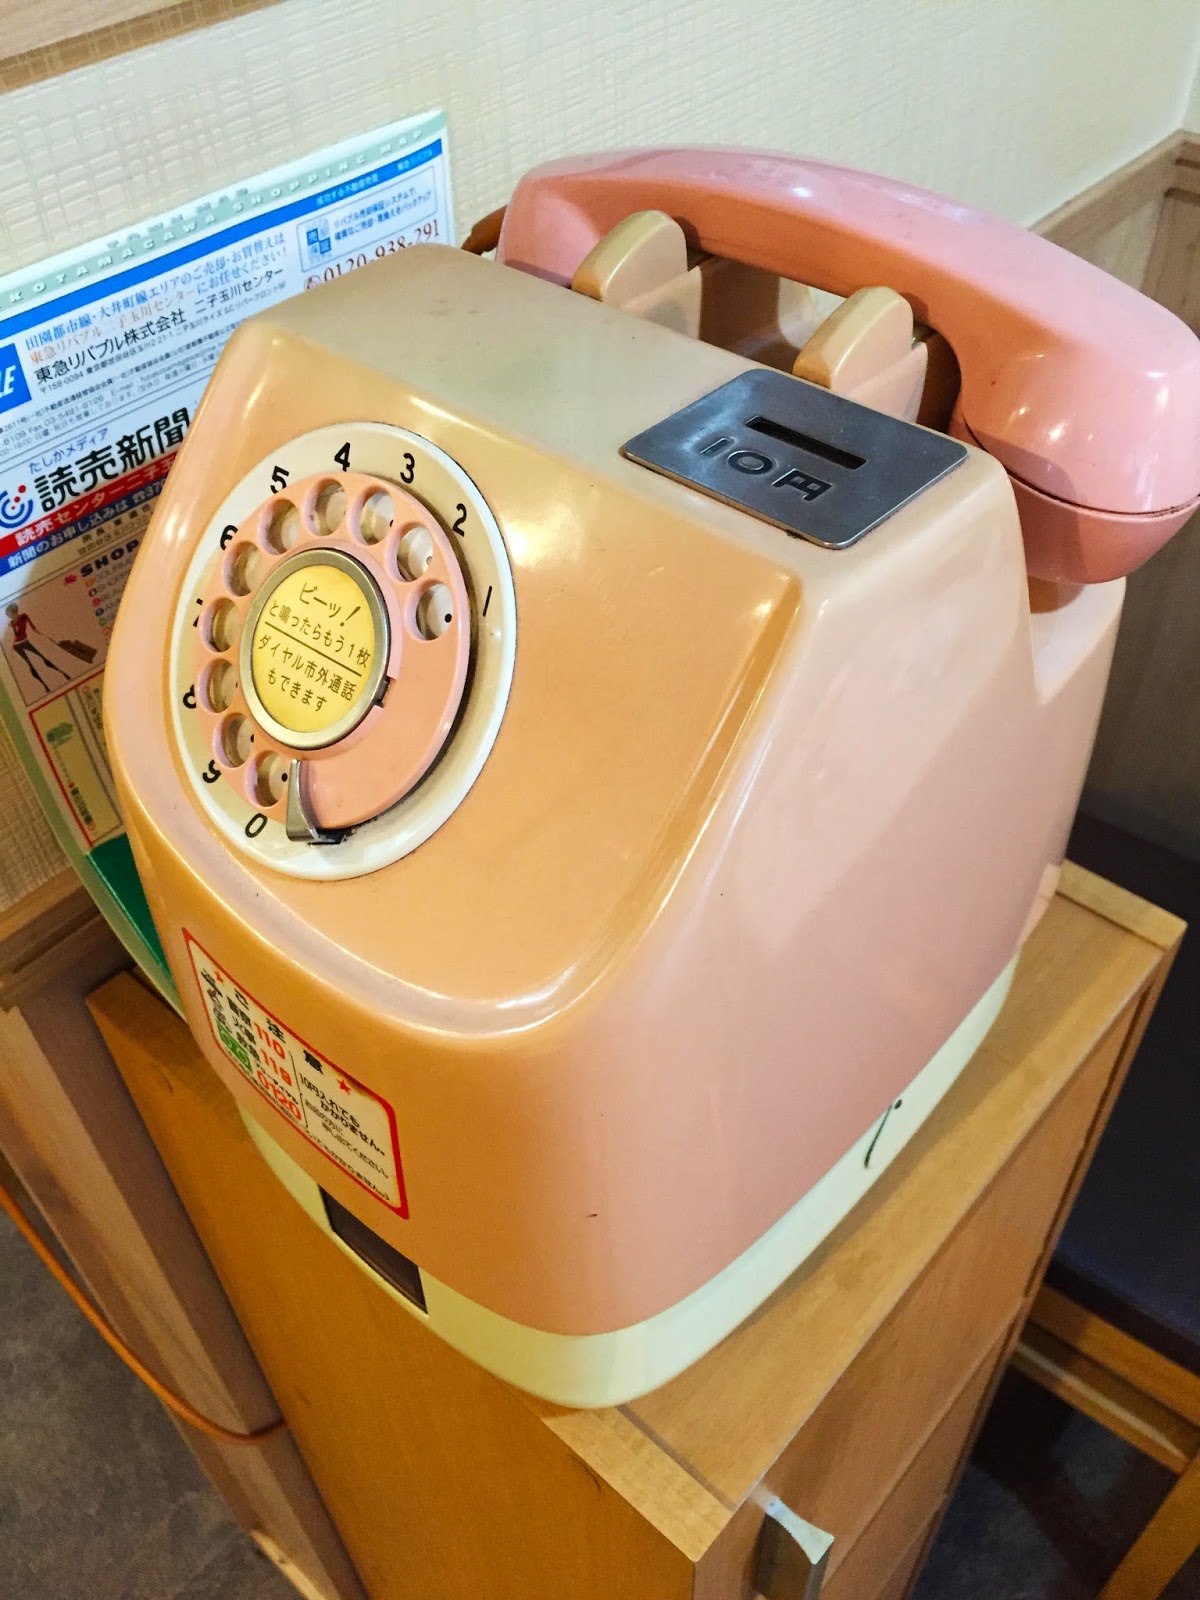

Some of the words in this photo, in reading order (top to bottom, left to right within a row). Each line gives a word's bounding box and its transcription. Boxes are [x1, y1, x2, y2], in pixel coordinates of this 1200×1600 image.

[0, 213, 216, 310] KOTAMAGAWA
[34, 407, 190, 513] 読売新聞
[333, 441, 352, 472] 4
[399, 453, 416, 484] 3
[699, 436, 833, 502] 10円
[270, 466, 290, 494] 5
[452, 503, 468, 537] 2
[80, 538, 140, 578] SHOP
[482, 585, 494, 617] 1
[269, 599, 372, 669] と鳴ったらもう1枚
[258, 634, 357, 701] ダイヤル市外通話
[267, 669, 328, 712] もできます
[245, 812, 268, 839] 0
[254, 1021, 285, 1060] 110
[260, 1049, 292, 1087] 119
[257, 1070, 302, 1121] 0120
[299, 1072, 360, 1129] 10円入れても
[320, 1100, 386, 1157] かかりません。
